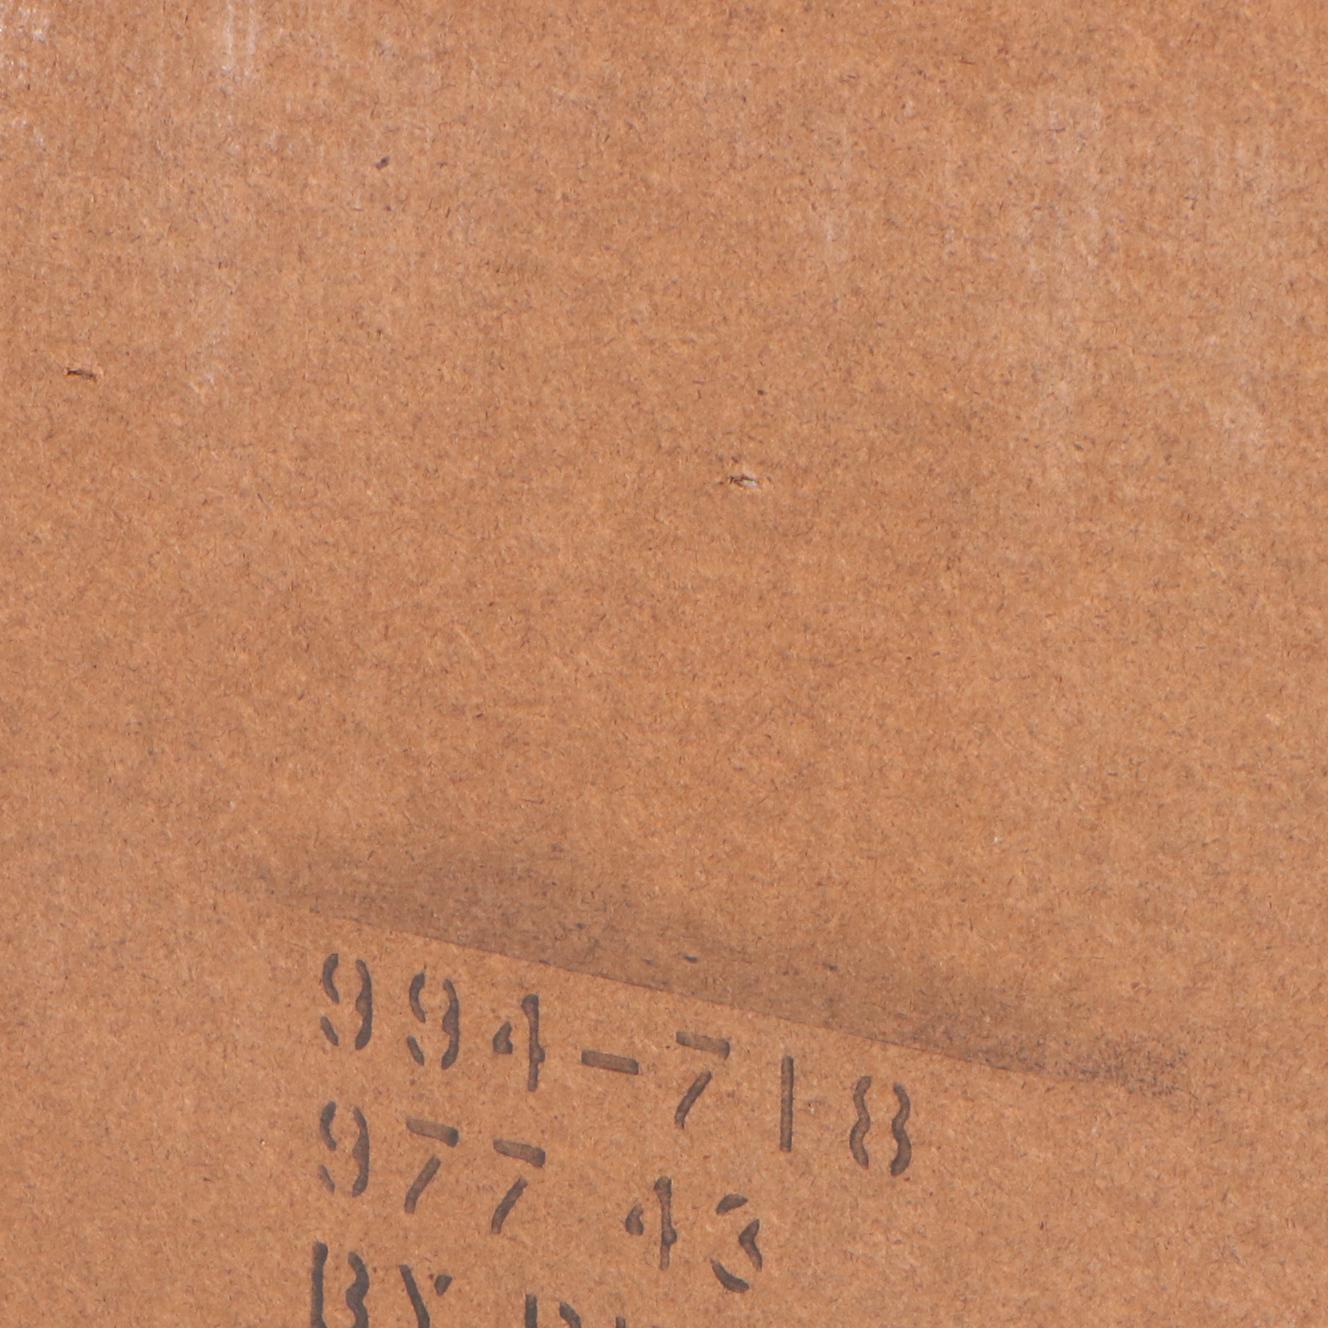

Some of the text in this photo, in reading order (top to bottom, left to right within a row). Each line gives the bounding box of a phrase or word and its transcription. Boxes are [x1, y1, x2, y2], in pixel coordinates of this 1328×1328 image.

[321, 952, 913, 1177] 994-718
[319, 1100, 764, 1294] 977 43
